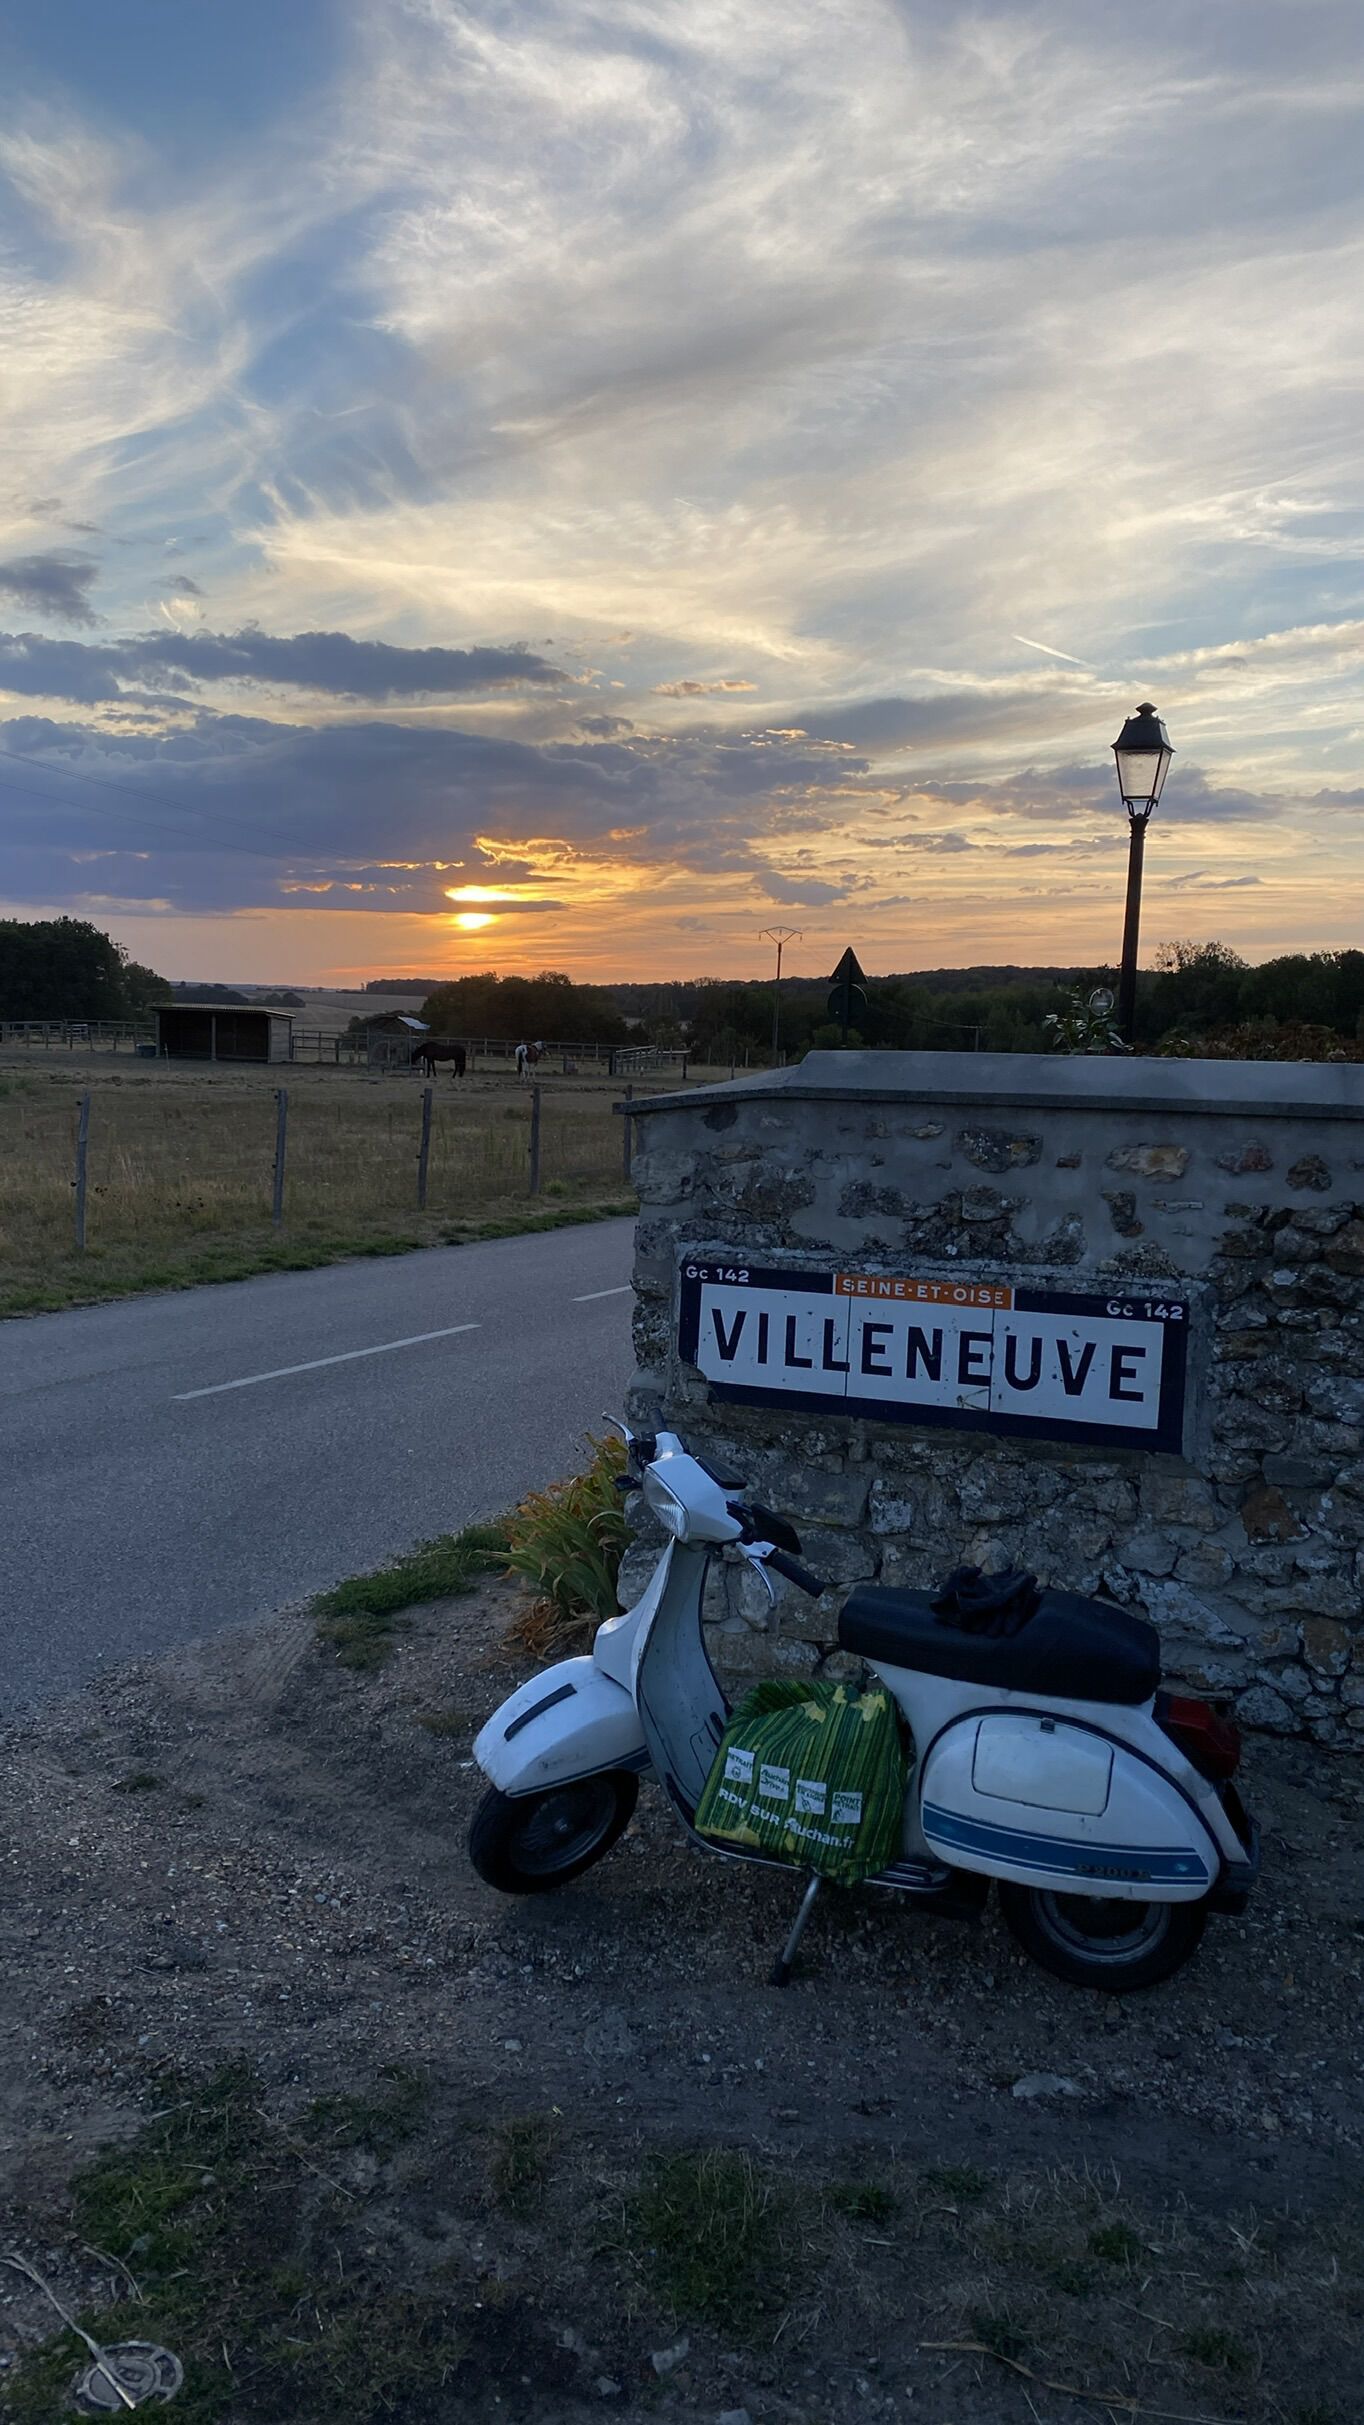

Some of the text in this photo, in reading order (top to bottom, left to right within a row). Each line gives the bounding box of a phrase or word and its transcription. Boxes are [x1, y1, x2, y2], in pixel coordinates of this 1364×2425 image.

[716, 1268, 750, 1283] 142
[1144, 1303, 1183, 1320] 142
[711, 1308, 1147, 1403] VILLENEUVE
[834, 1793, 861, 1805] POINT
[719, 1787, 856, 1848] RDV SUR Auchan.fr
